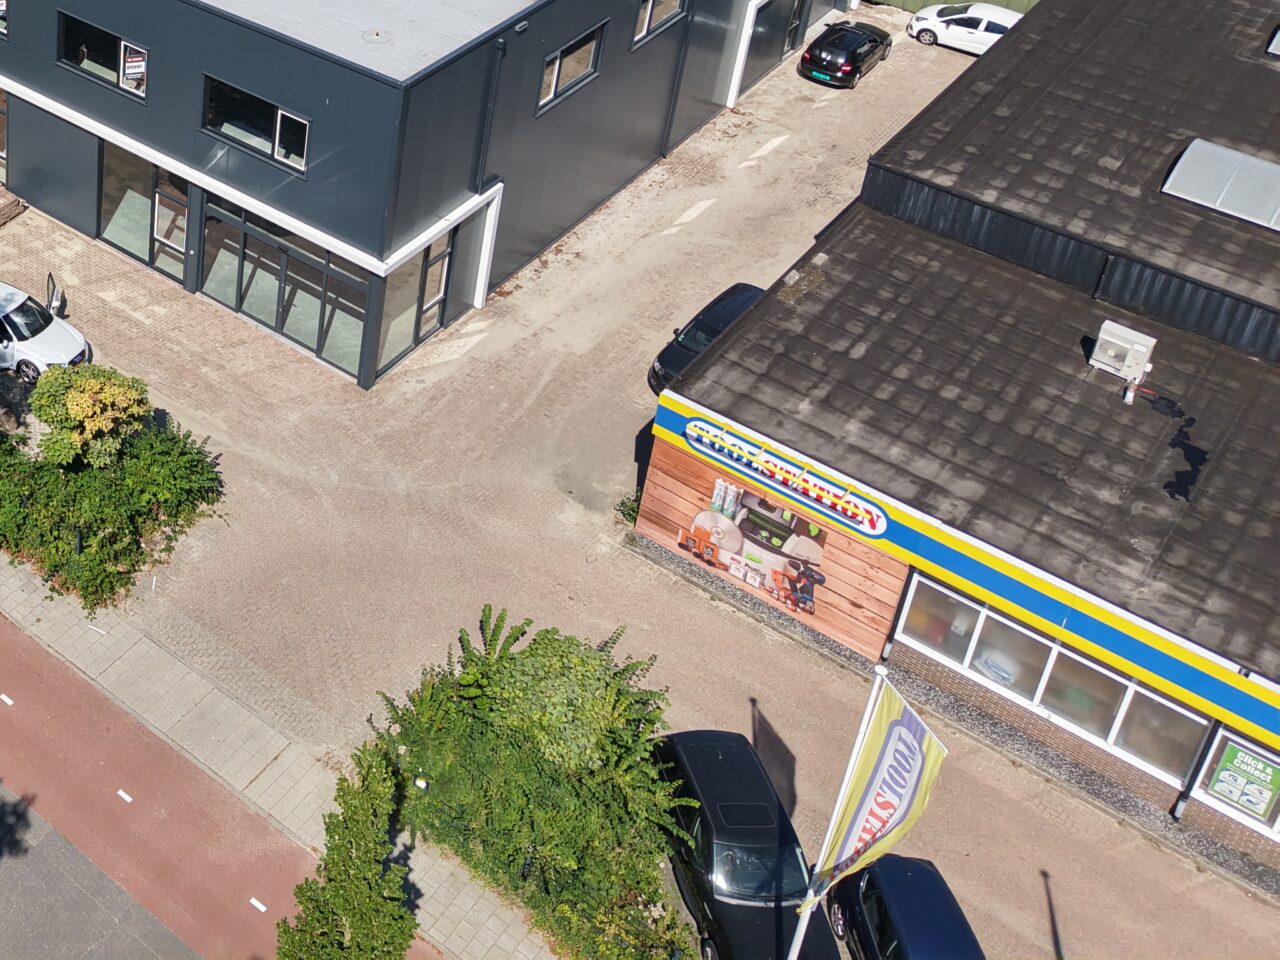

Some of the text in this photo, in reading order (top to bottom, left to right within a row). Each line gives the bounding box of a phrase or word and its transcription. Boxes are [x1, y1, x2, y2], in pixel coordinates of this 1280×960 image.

[693, 424, 882, 531] TOOLSTATION
[1233, 758, 1272, 783] Collect
[1236, 751, 1273, 775] Click &
[830, 733, 919, 880] TOOLSTA
